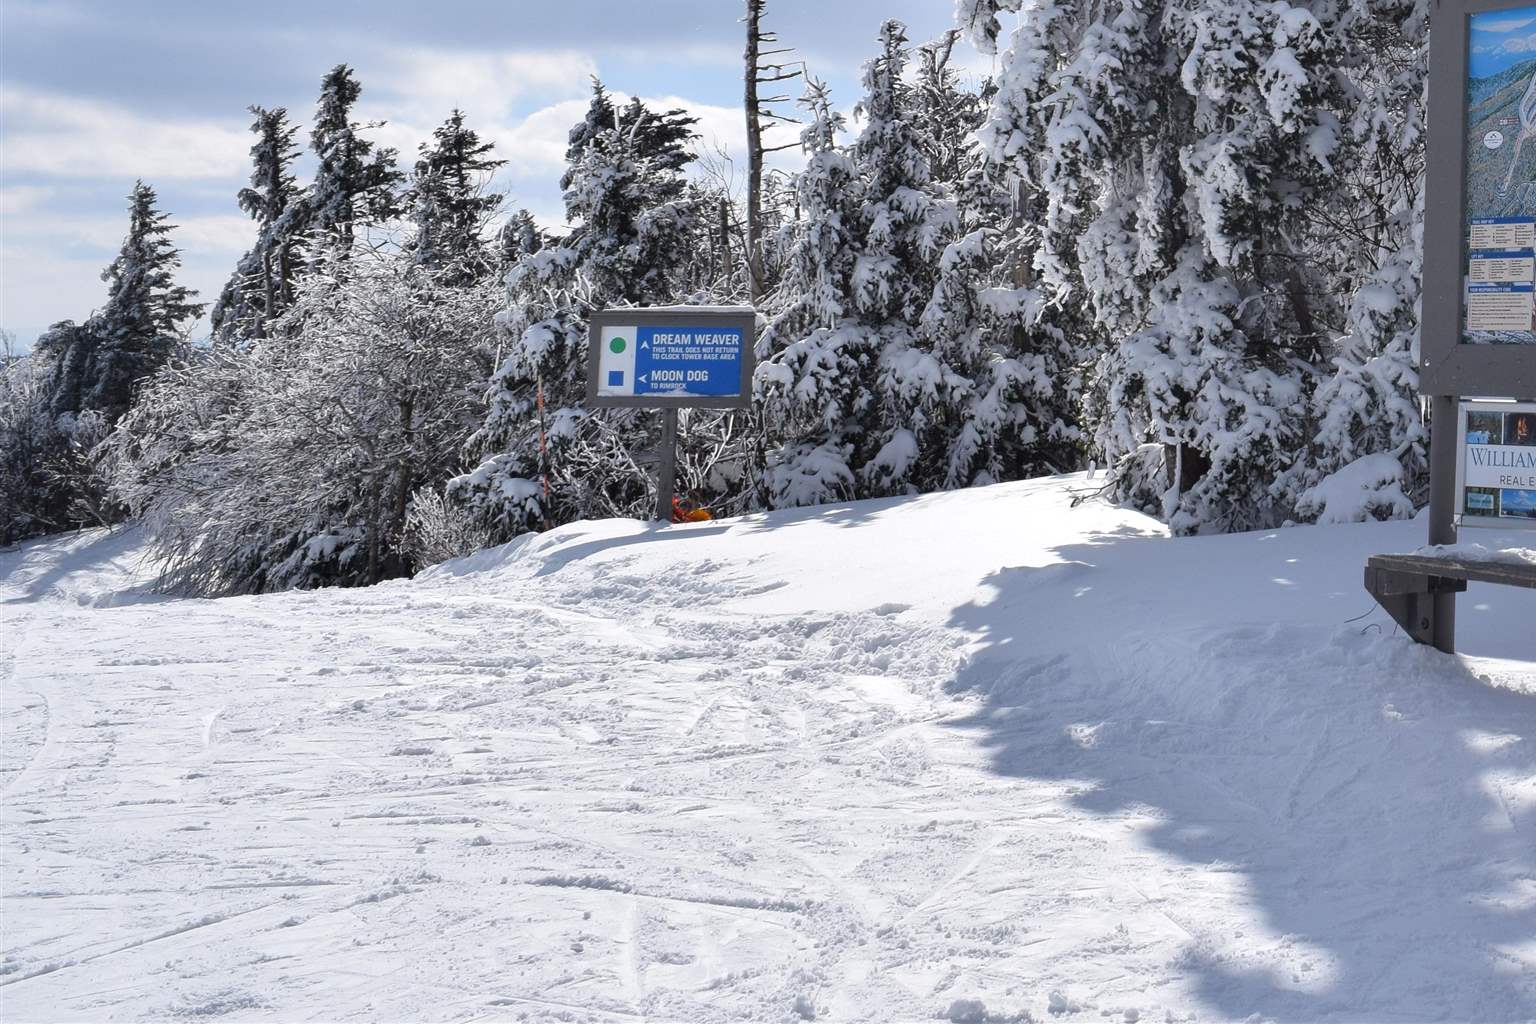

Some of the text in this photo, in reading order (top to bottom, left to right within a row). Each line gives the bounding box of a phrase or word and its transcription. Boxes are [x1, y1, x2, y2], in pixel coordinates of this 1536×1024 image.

[653, 334, 739, 345] DREAM WEAVER
[651, 370, 709, 381] MOON DOG
[1501, 475, 1526, 486] REAL
